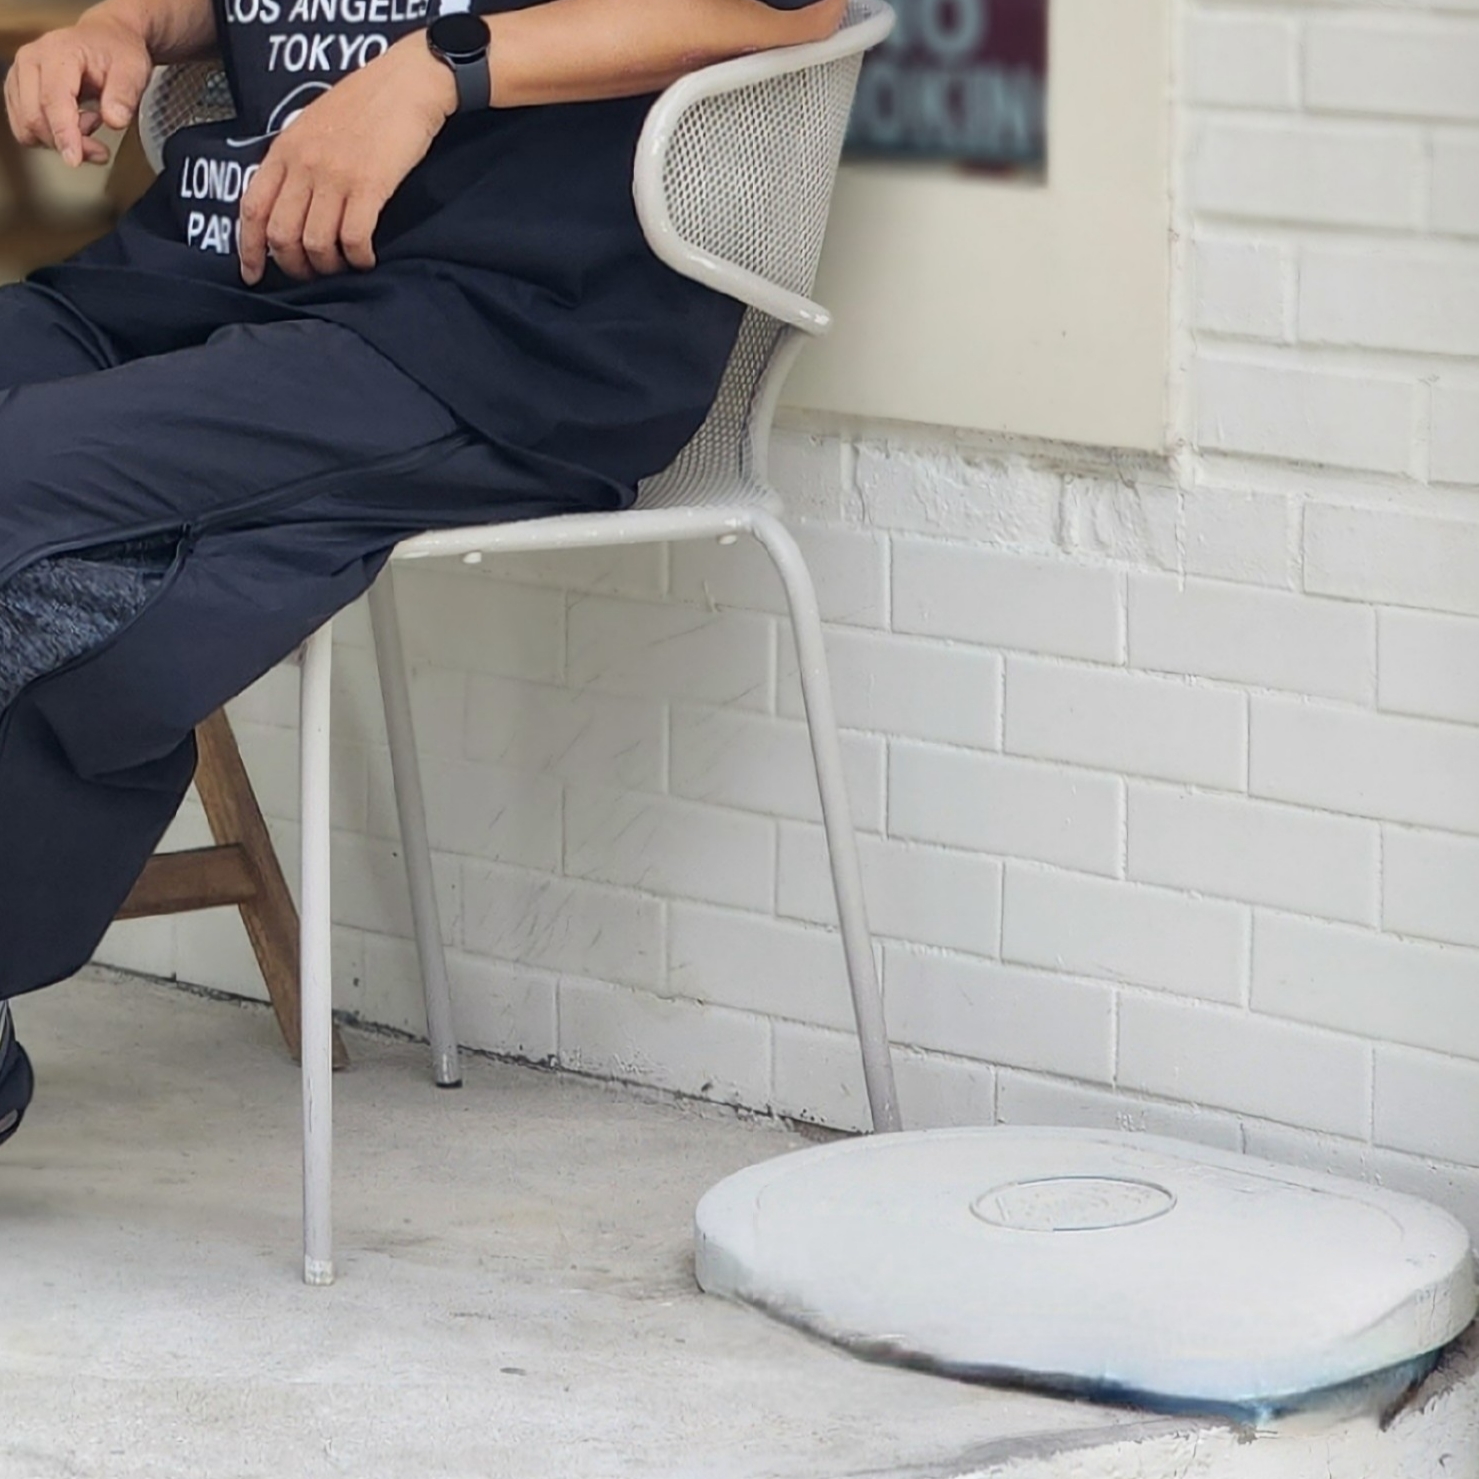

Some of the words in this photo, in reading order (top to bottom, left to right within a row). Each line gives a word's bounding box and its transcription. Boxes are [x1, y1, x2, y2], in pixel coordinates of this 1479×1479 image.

[269, 33, 388, 72] TOKYO
[181, 156, 260, 203] LOND
[187, 210, 242, 255] PAR
